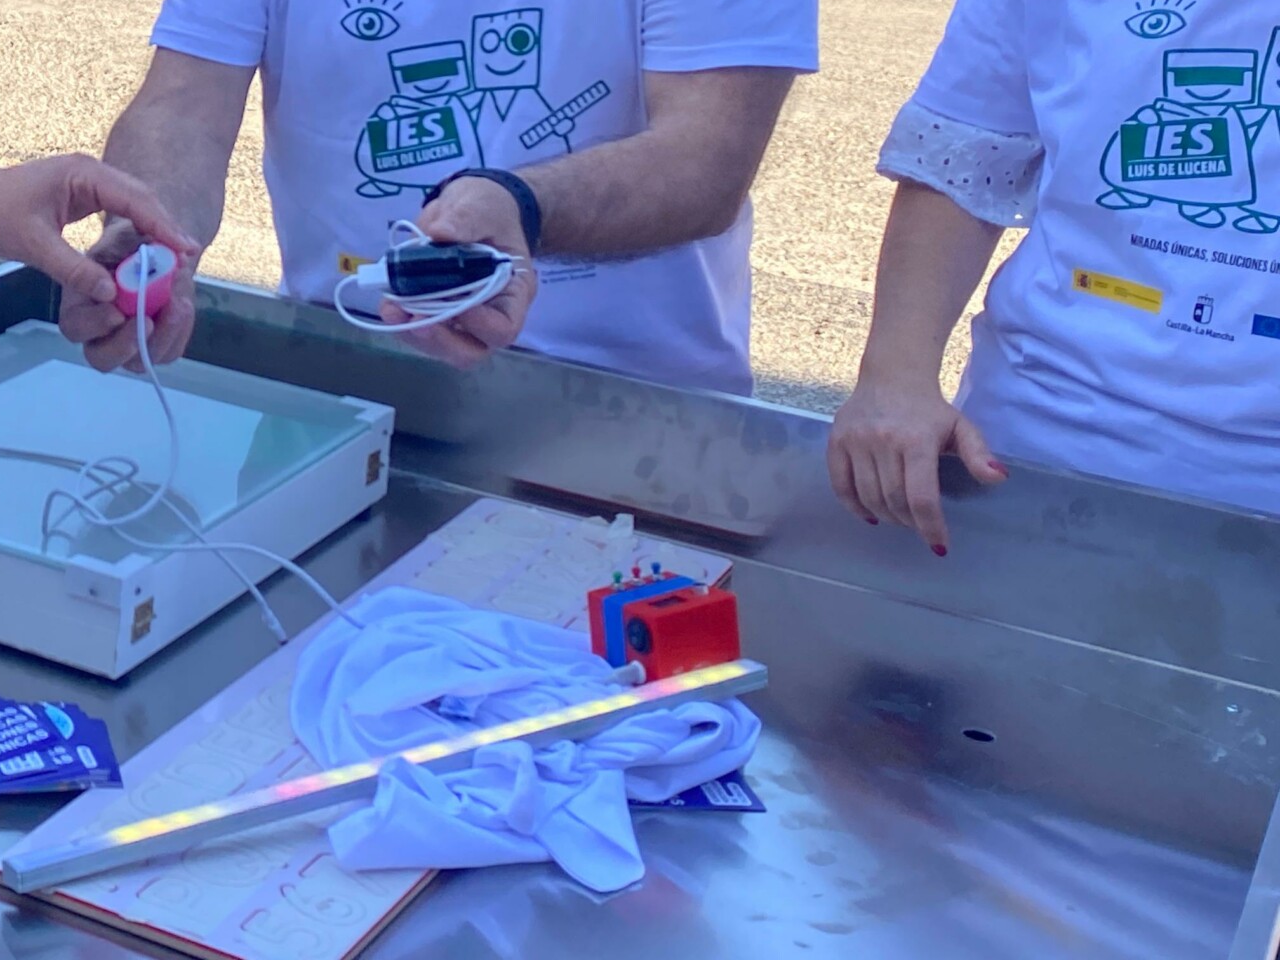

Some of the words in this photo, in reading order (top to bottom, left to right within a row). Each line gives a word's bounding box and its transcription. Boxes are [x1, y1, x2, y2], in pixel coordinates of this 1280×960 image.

[387, 112, 445, 150] IES
[1144, 123, 1214, 158] IES
[376, 155, 399, 169] LUIS
[400, 151, 416, 165] DE
[416, 143, 459, 162] LUCENA
[1128, 164, 1155, 178] LUIS
[1158, 162, 1175, 176] DE
[1177, 160, 1227, 175] LUCENA
[1211, 251, 1268, 272] SOLUCIONES
